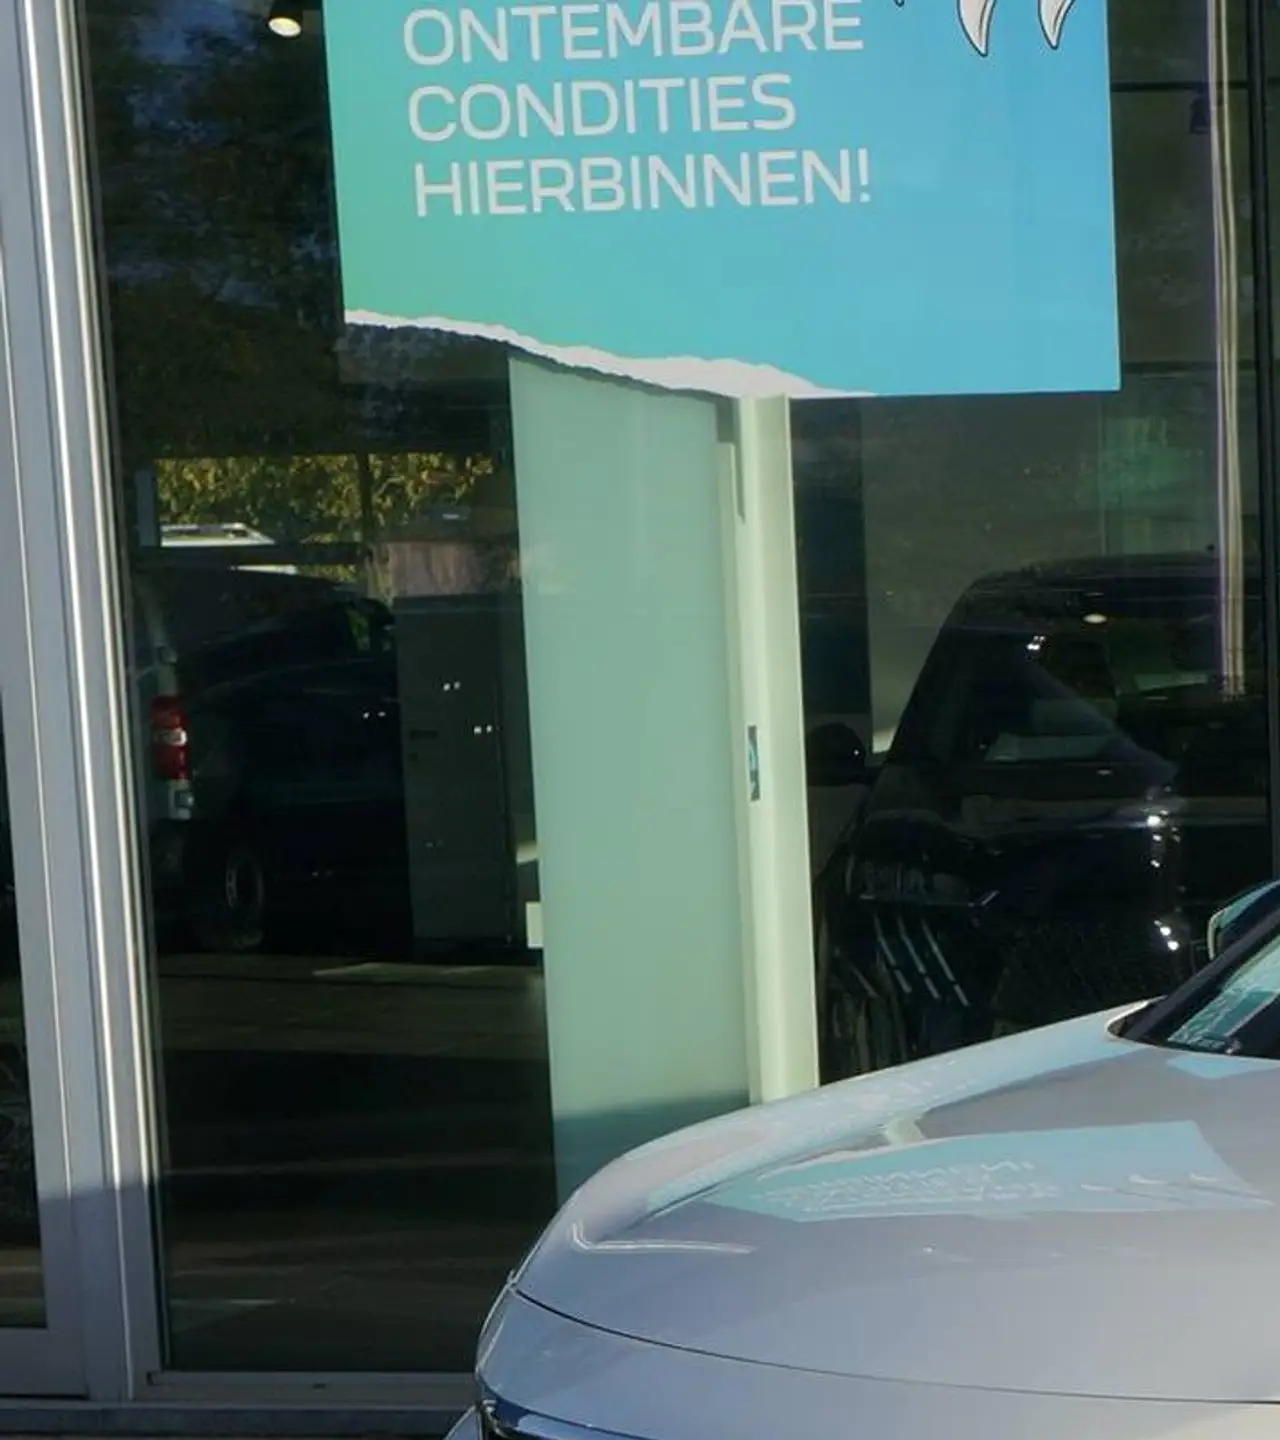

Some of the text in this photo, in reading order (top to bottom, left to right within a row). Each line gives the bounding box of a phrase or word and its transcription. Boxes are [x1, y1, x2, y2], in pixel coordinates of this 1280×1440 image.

[403, 0, 864, 66] ONTEMBARE
[408, 73, 797, 142] CONDITIES
[414, 148, 871, 217] HIERBINNEN!
